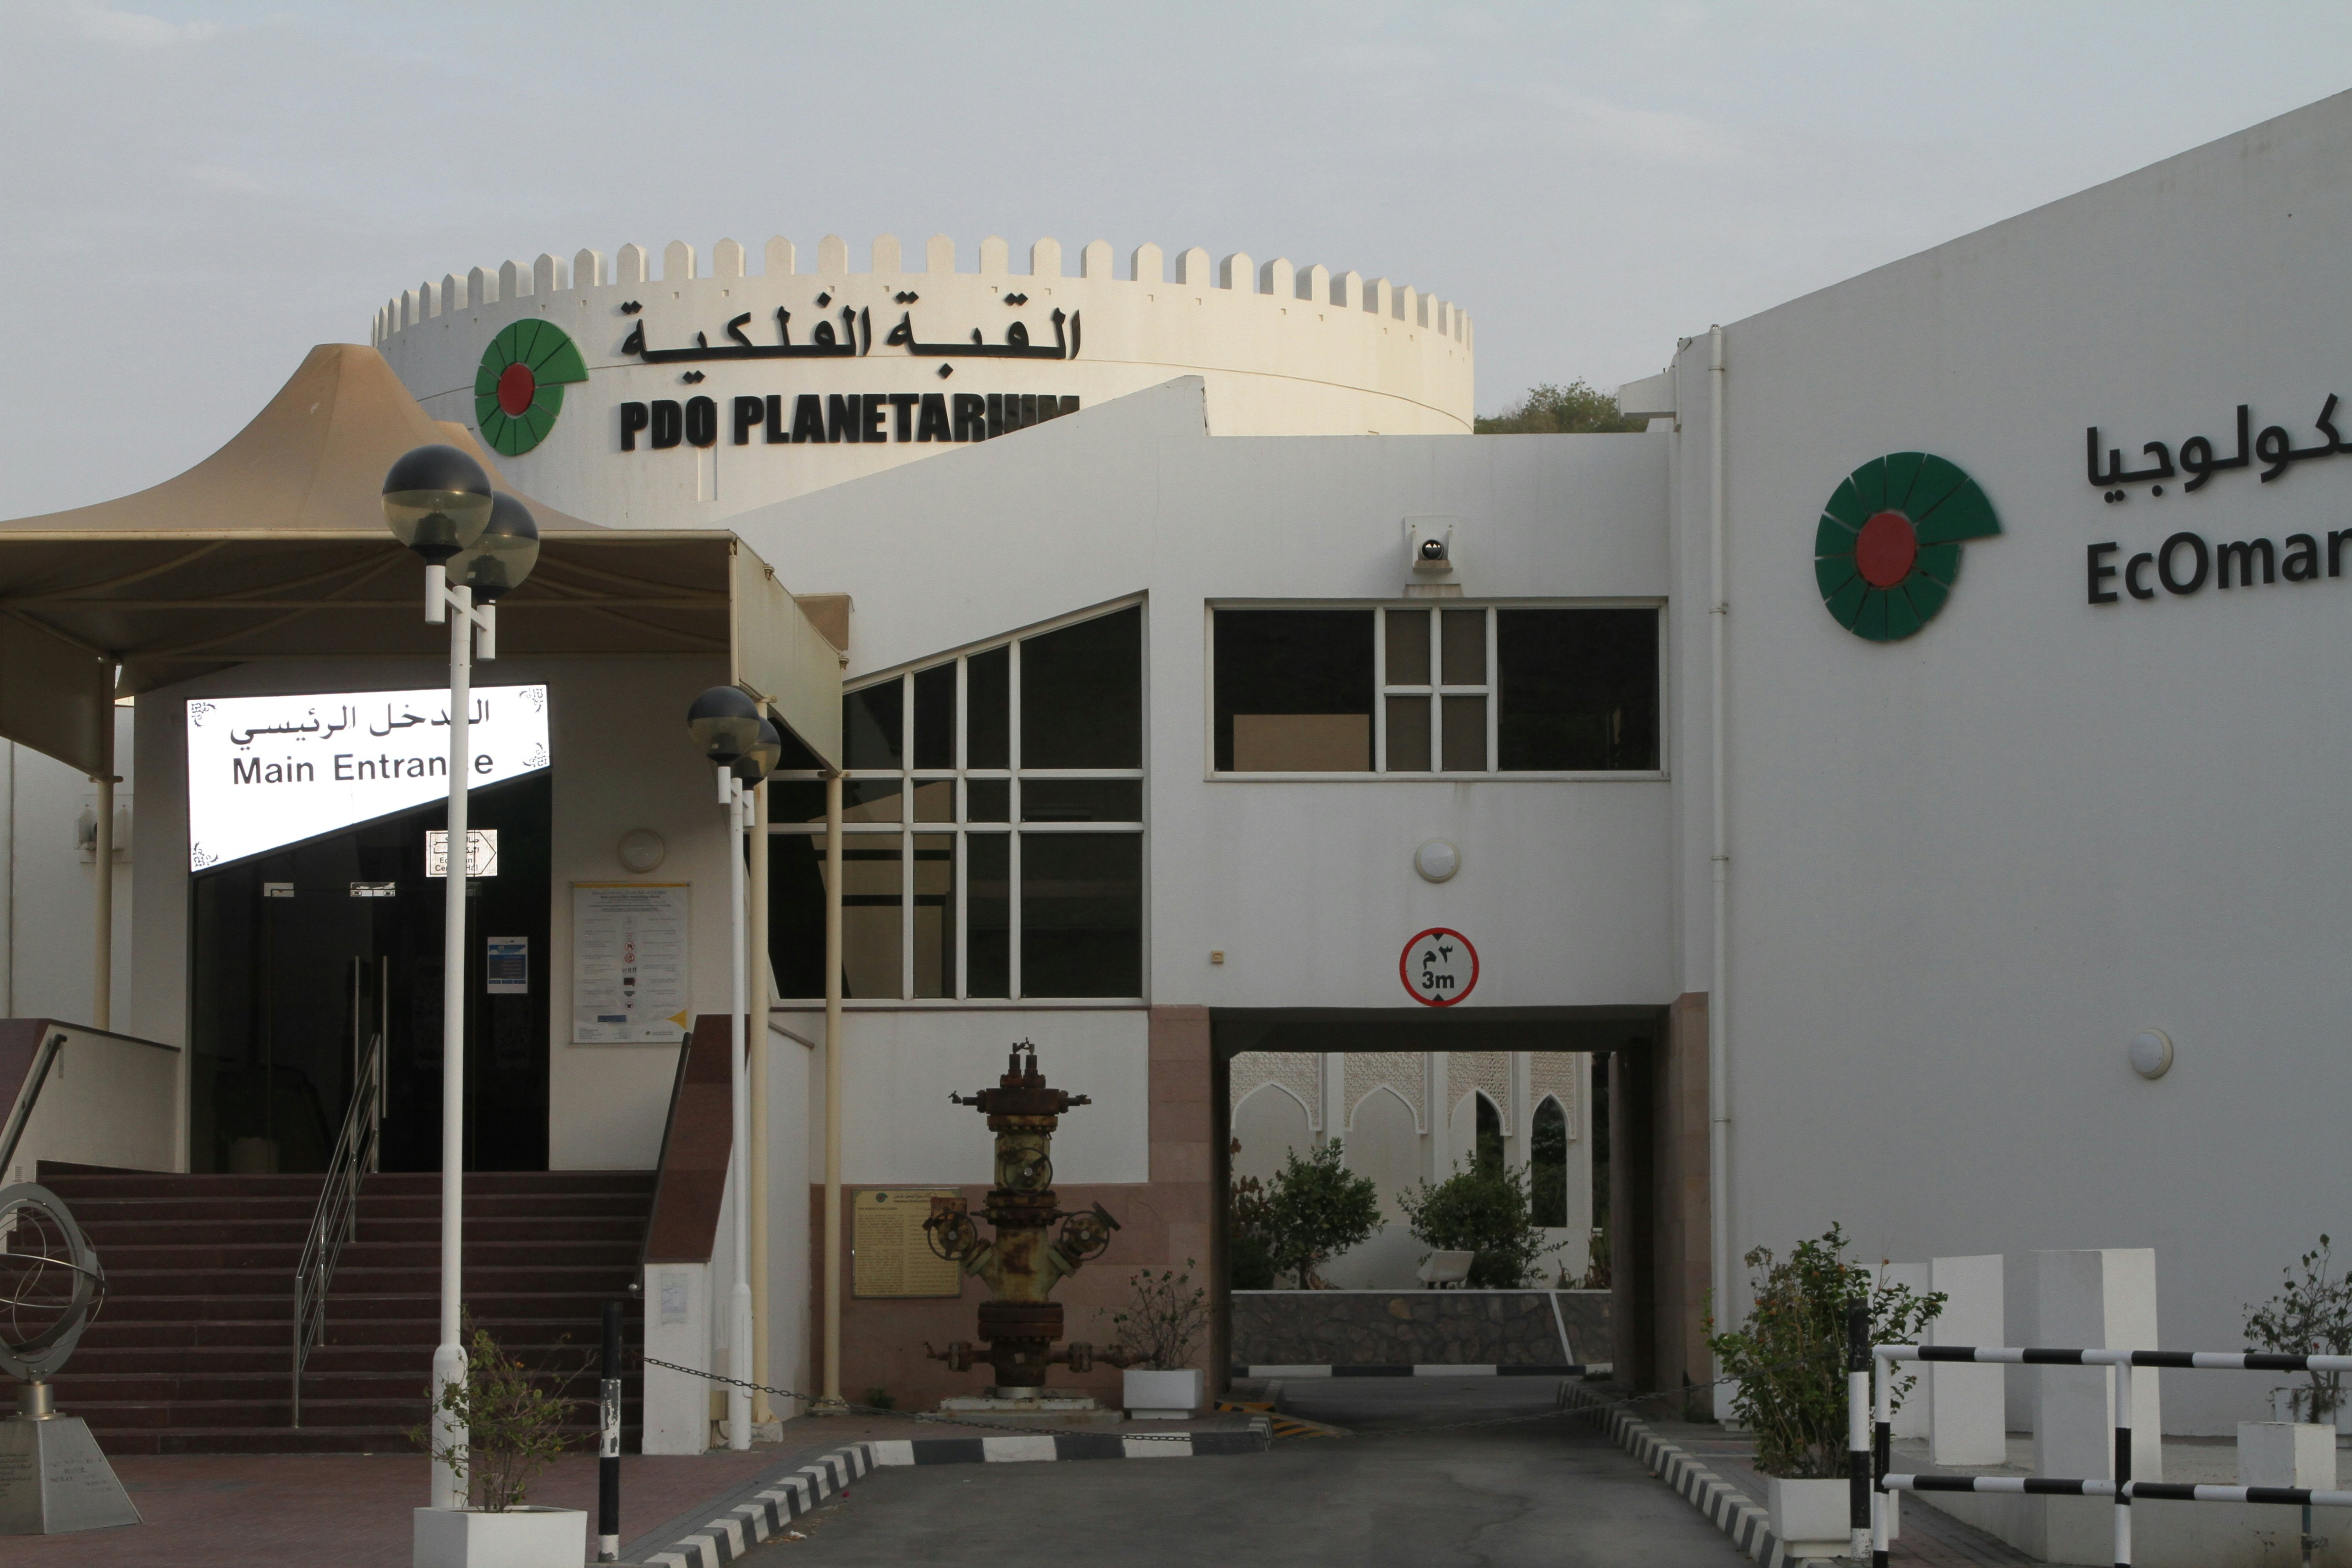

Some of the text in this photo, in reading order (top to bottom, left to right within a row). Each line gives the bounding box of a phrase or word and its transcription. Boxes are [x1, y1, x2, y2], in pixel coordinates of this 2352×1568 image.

[621, 291, 1081, 384] القبة الفلكية
[621, 396, 717, 452] PDO
[2087, 393, 2352, 504] كولوجيا
[231, 699, 489, 751] الدخل الرئيسي
[233, 754, 493, 784] Main Entrane
[1422, 970, 1455, 989] 3m
